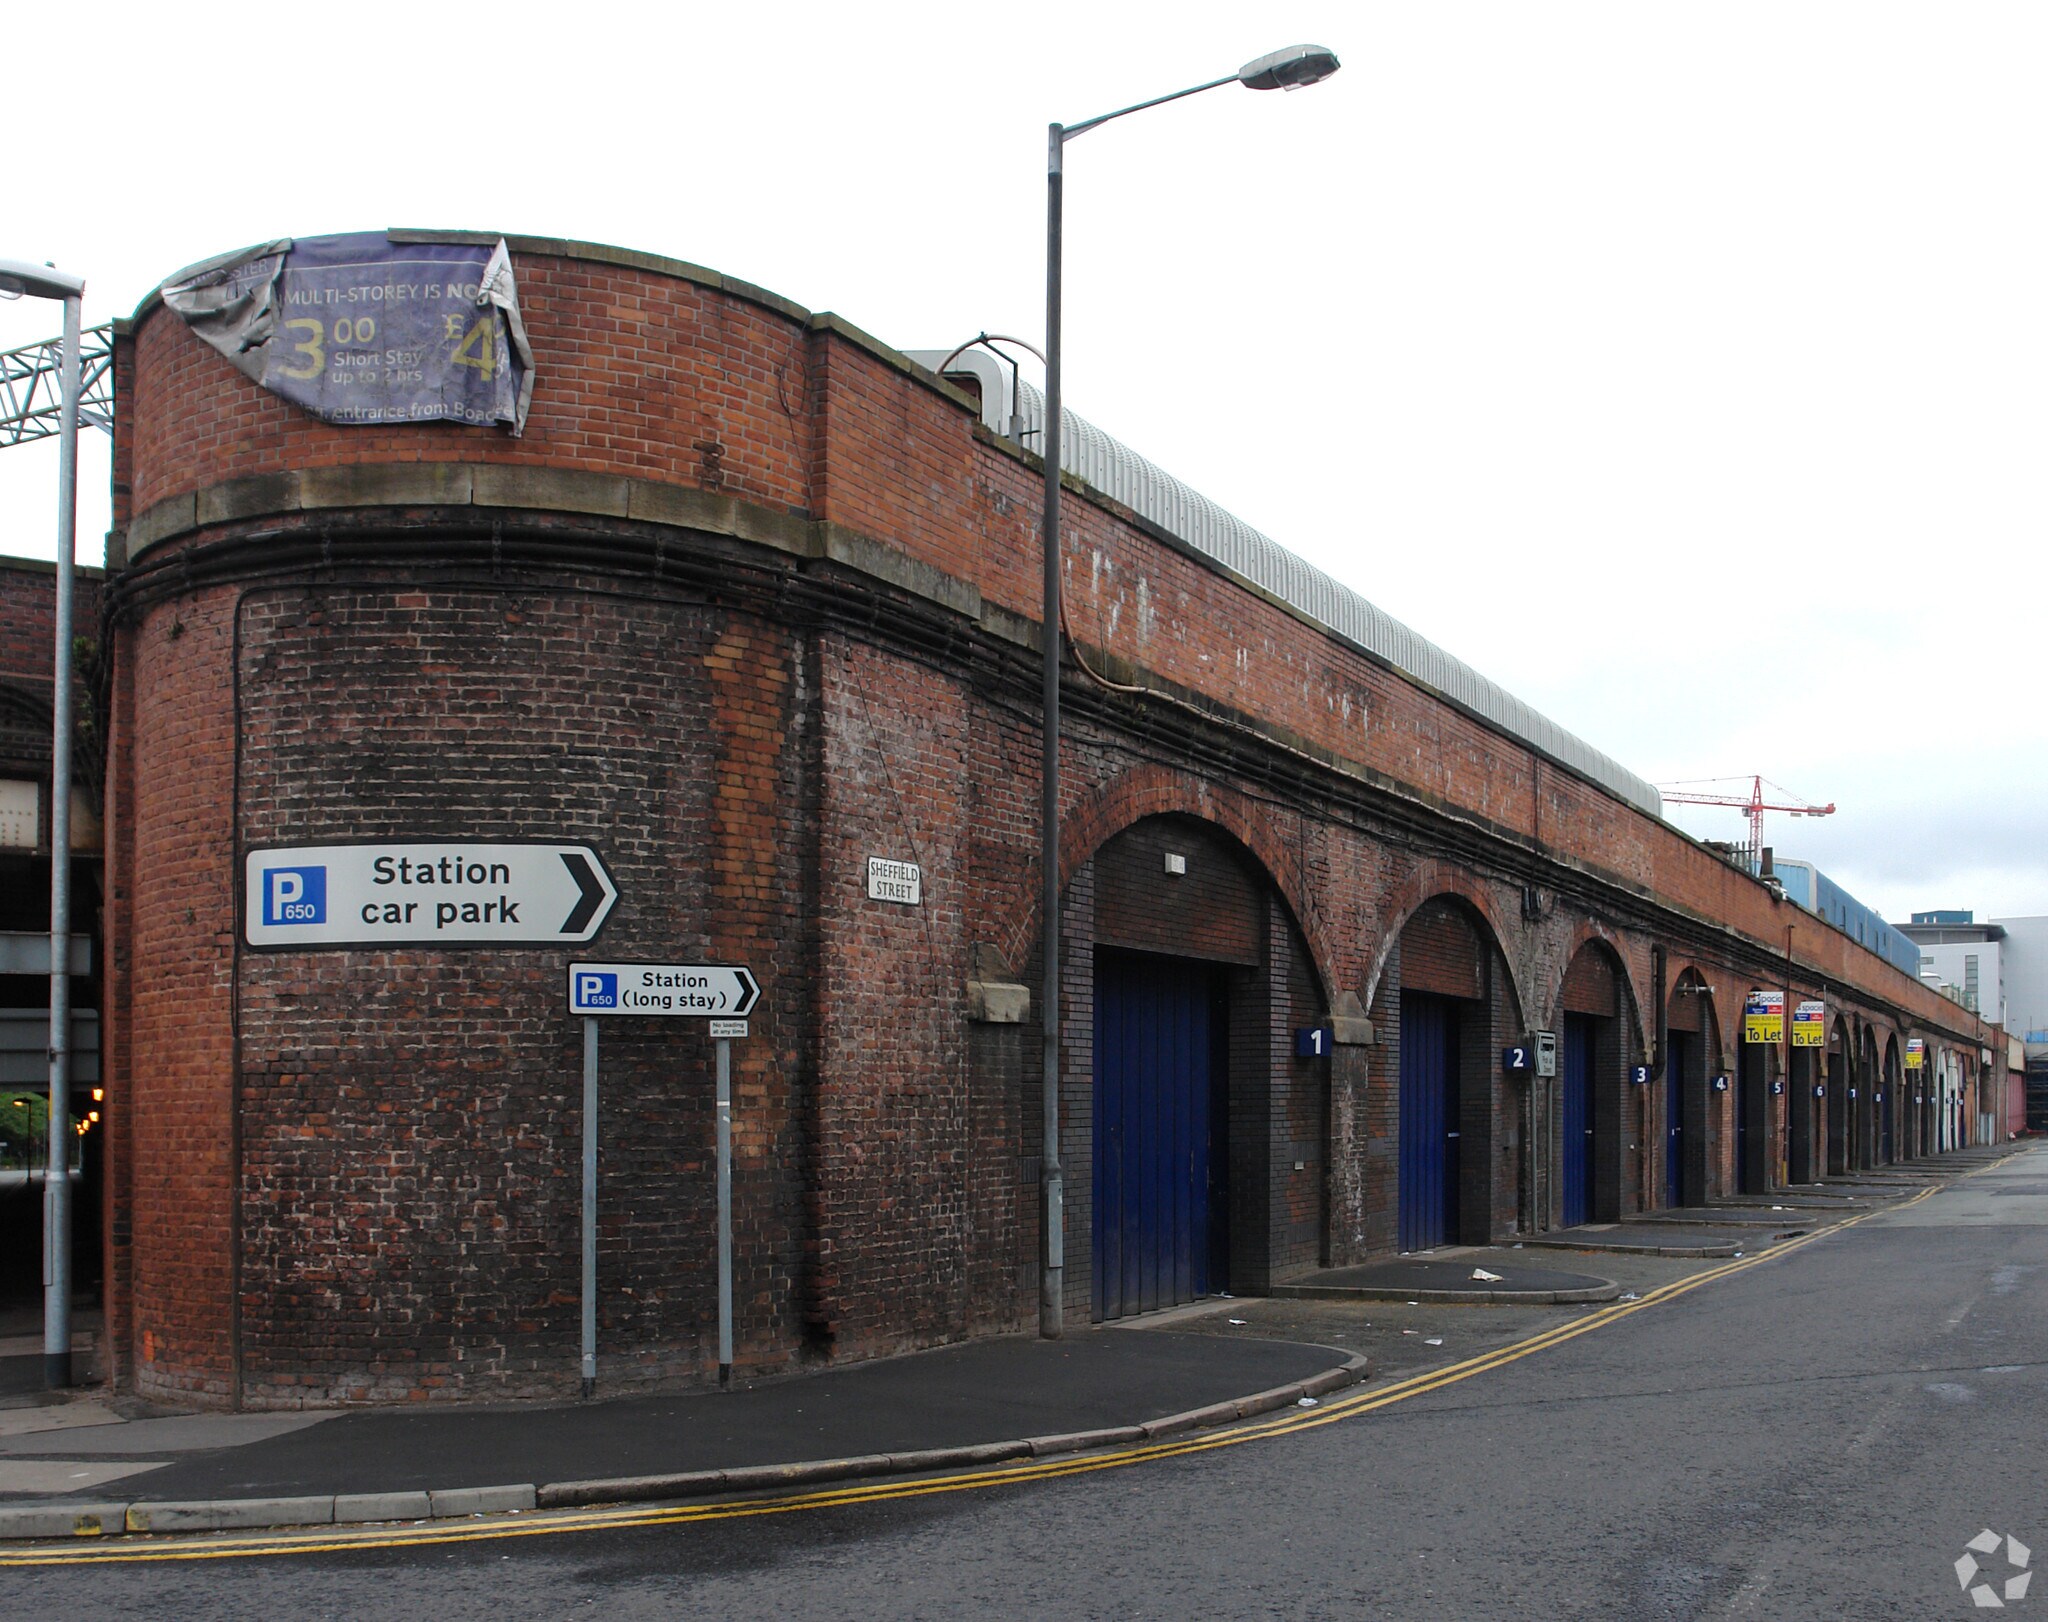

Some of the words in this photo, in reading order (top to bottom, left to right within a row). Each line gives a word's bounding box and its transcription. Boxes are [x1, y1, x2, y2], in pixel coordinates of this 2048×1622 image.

[284, 284, 418, 305] MULTI-STOREY
[425, 284, 442, 299] IS
[446, 283, 478, 299] NO
[334, 352, 381, 367] Short
[385, 350, 423, 367] Stay
[332, 373, 353, 386] up
[359, 372, 376, 384] to
[396, 369, 423, 382] hrs
[412, 402, 448, 417] from
[372, 856, 510, 884] Station
[871, 861, 919, 882] SHEFFIELD
[272, 872, 304, 921] P
[877, 880, 912, 899] STREET
[285, 904, 316, 919] 650
[361, 902, 418, 924] car
[436, 895, 521, 929] park
[642, 972, 708, 988] Station
[581, 976, 603, 1005] P
[591, 995, 613, 1005] 650
[623, 990, 672, 1009] (long
[679, 991, 727, 1010] stay)
[1310, 1030, 1322, 1055] 1
[1747, 1028, 1760, 1041] To
[1764, 1028, 1781, 1041] Let
[1794, 1033, 1804, 1045] To
[1807, 1033, 1822, 1045] Let
[1513, 1048, 1524, 1067] 2
[1637, 1068, 1646, 1083] 3
[1716, 1077, 1726, 1090] 4
[1774, 1082, 1781, 1094] 5
[1817, 1086, 1823, 1096] 6
[1850, 1089, 1856, 1098] 7
[1876, 1093, 1881, 1102] 8
